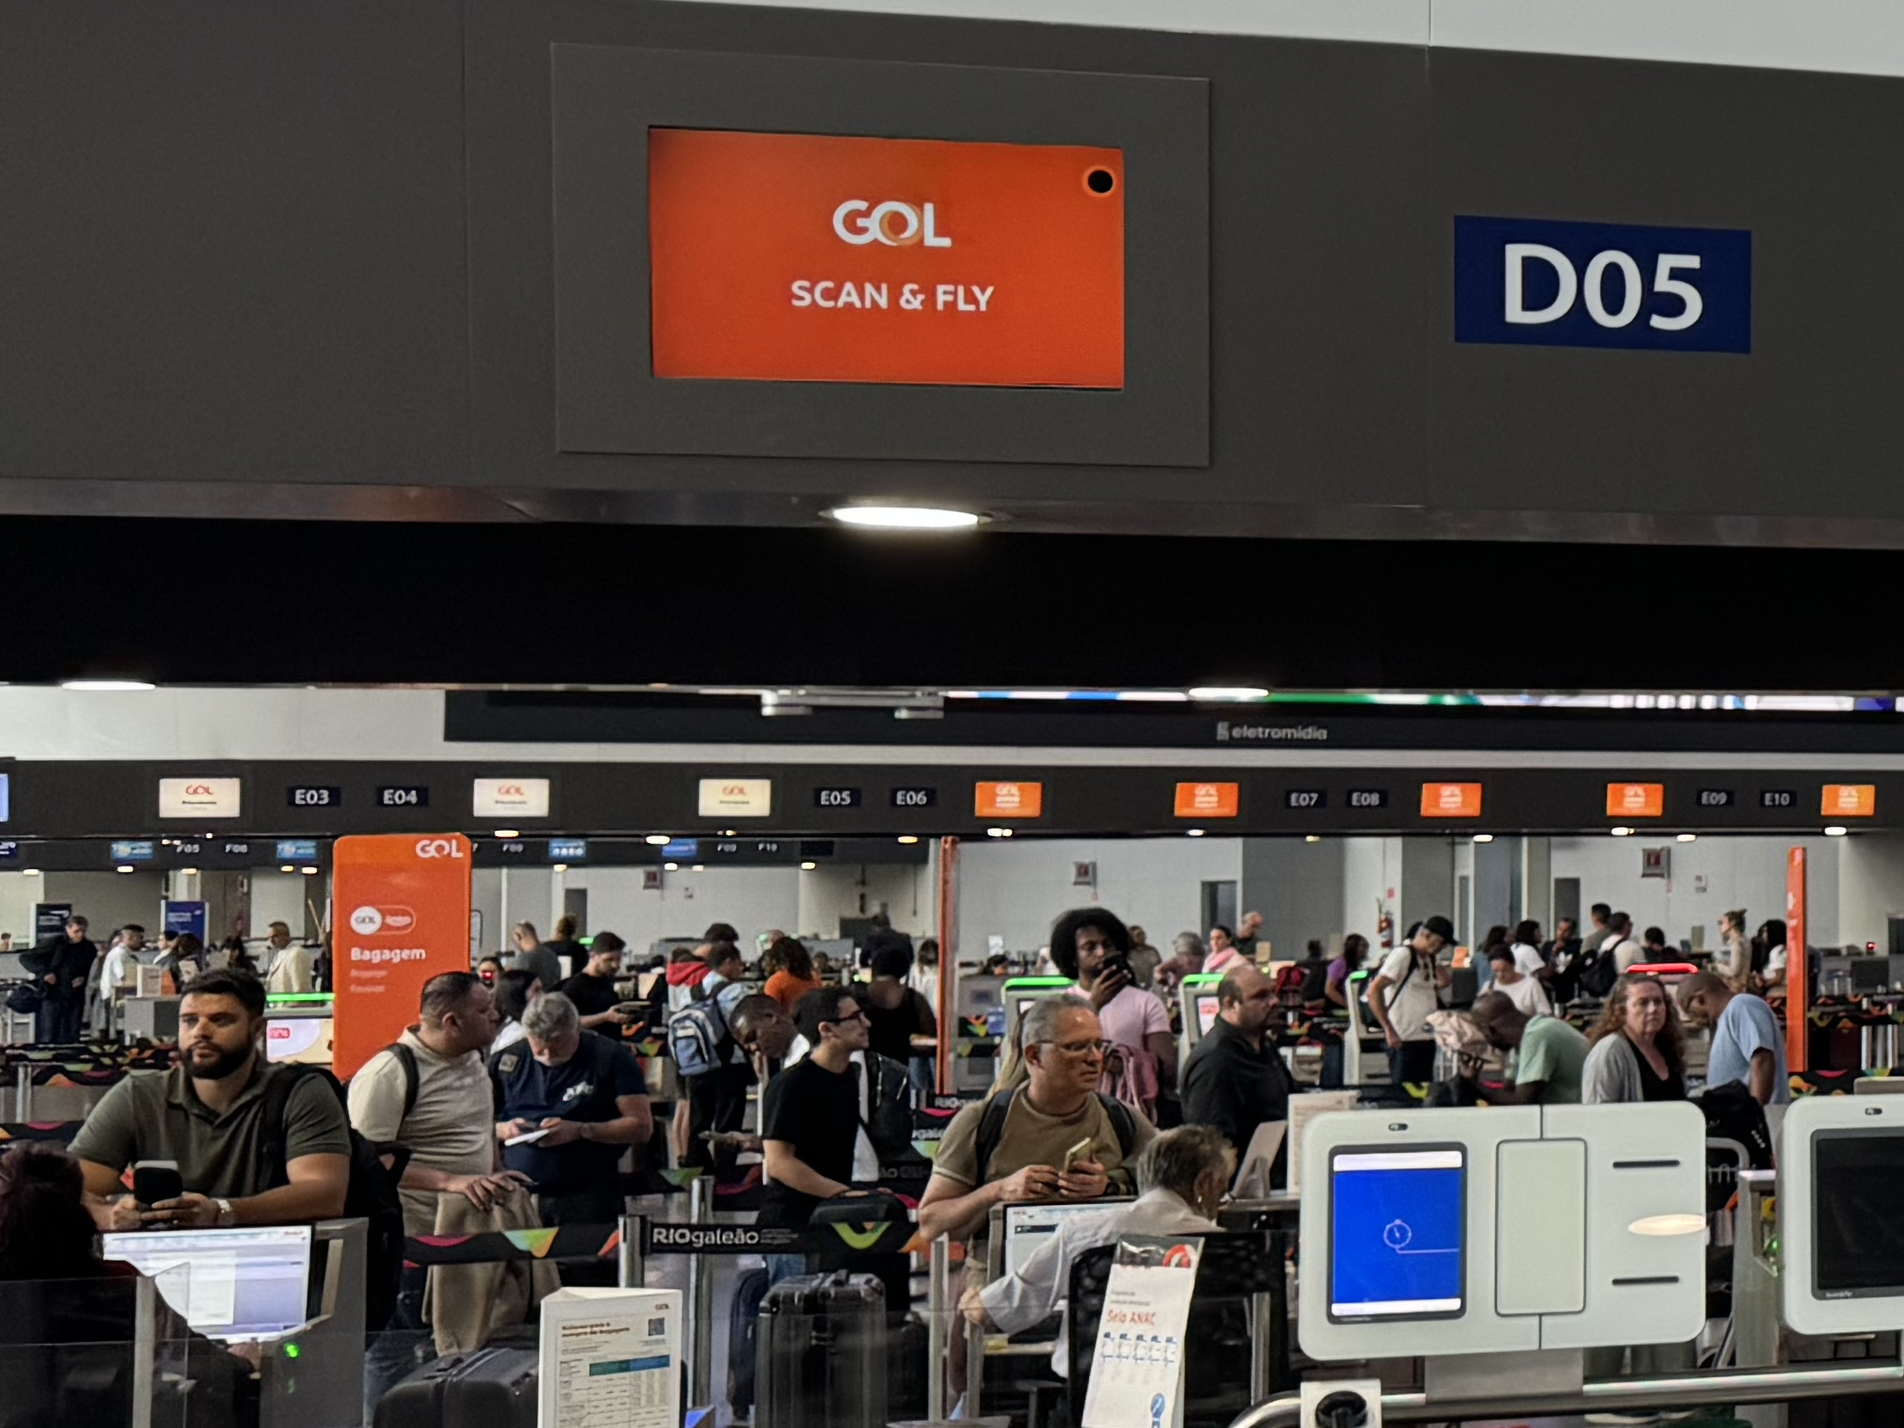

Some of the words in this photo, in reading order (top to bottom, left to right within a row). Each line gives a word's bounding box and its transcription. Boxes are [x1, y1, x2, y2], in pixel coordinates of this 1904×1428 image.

[832, 199, 952, 248] GOL
[1504, 242, 1703, 331] D05
[791, 280, 889, 310] SCAN
[899, 283, 926, 311] &
[936, 284, 995, 312] FLY
[1232, 722, 1328, 740] eletromidia
[295, 789, 330, 805] E03
[383, 789, 418, 805] E04
[820, 790, 851, 805] E05
[896, 790, 927, 805] E06
[1290, 792, 1318, 806] E07
[1351, 792, 1380, 806] E08
[1701, 791, 1727, 805] E09
[1764, 792, 1790, 806] E10
[415, 839, 464, 859] GOL
[350, 947, 427, 964] Bagagem
[652, 1227, 760, 1248] RIOgaleão
